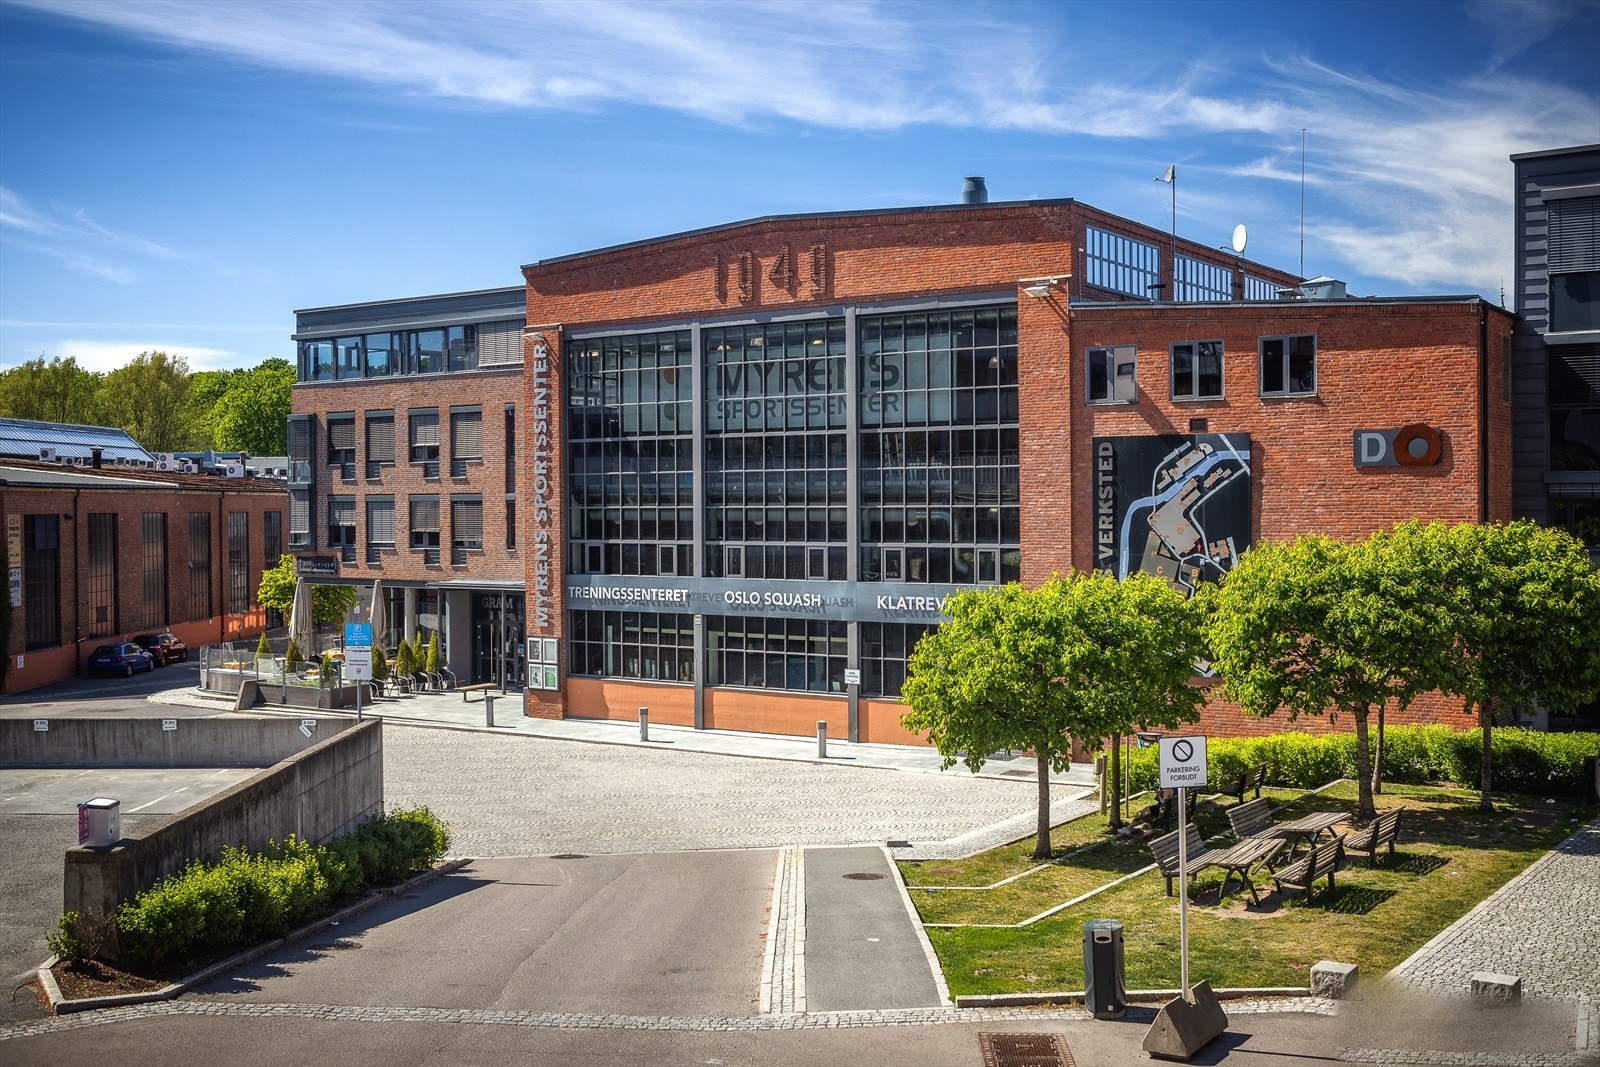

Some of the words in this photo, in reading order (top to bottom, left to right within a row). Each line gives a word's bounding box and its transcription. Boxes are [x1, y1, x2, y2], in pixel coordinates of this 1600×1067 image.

[716, 348, 900, 397] MYRENS
[533, 343, 548, 522] SPORTSSENTER
[1098, 442, 1114, 560] VERKSTED
[534, 529, 549, 627] MYRENS
[568, 586, 689, 602] TRENINGSSENTERET
[724, 590, 761, 604] OSLO
[764, 592, 821, 607] SQUASH
[877, 595, 946, 611] KLATREV
[1166, 766, 1200, 774] PARKERING
[1170, 773, 1197, 781] FORBUDT
